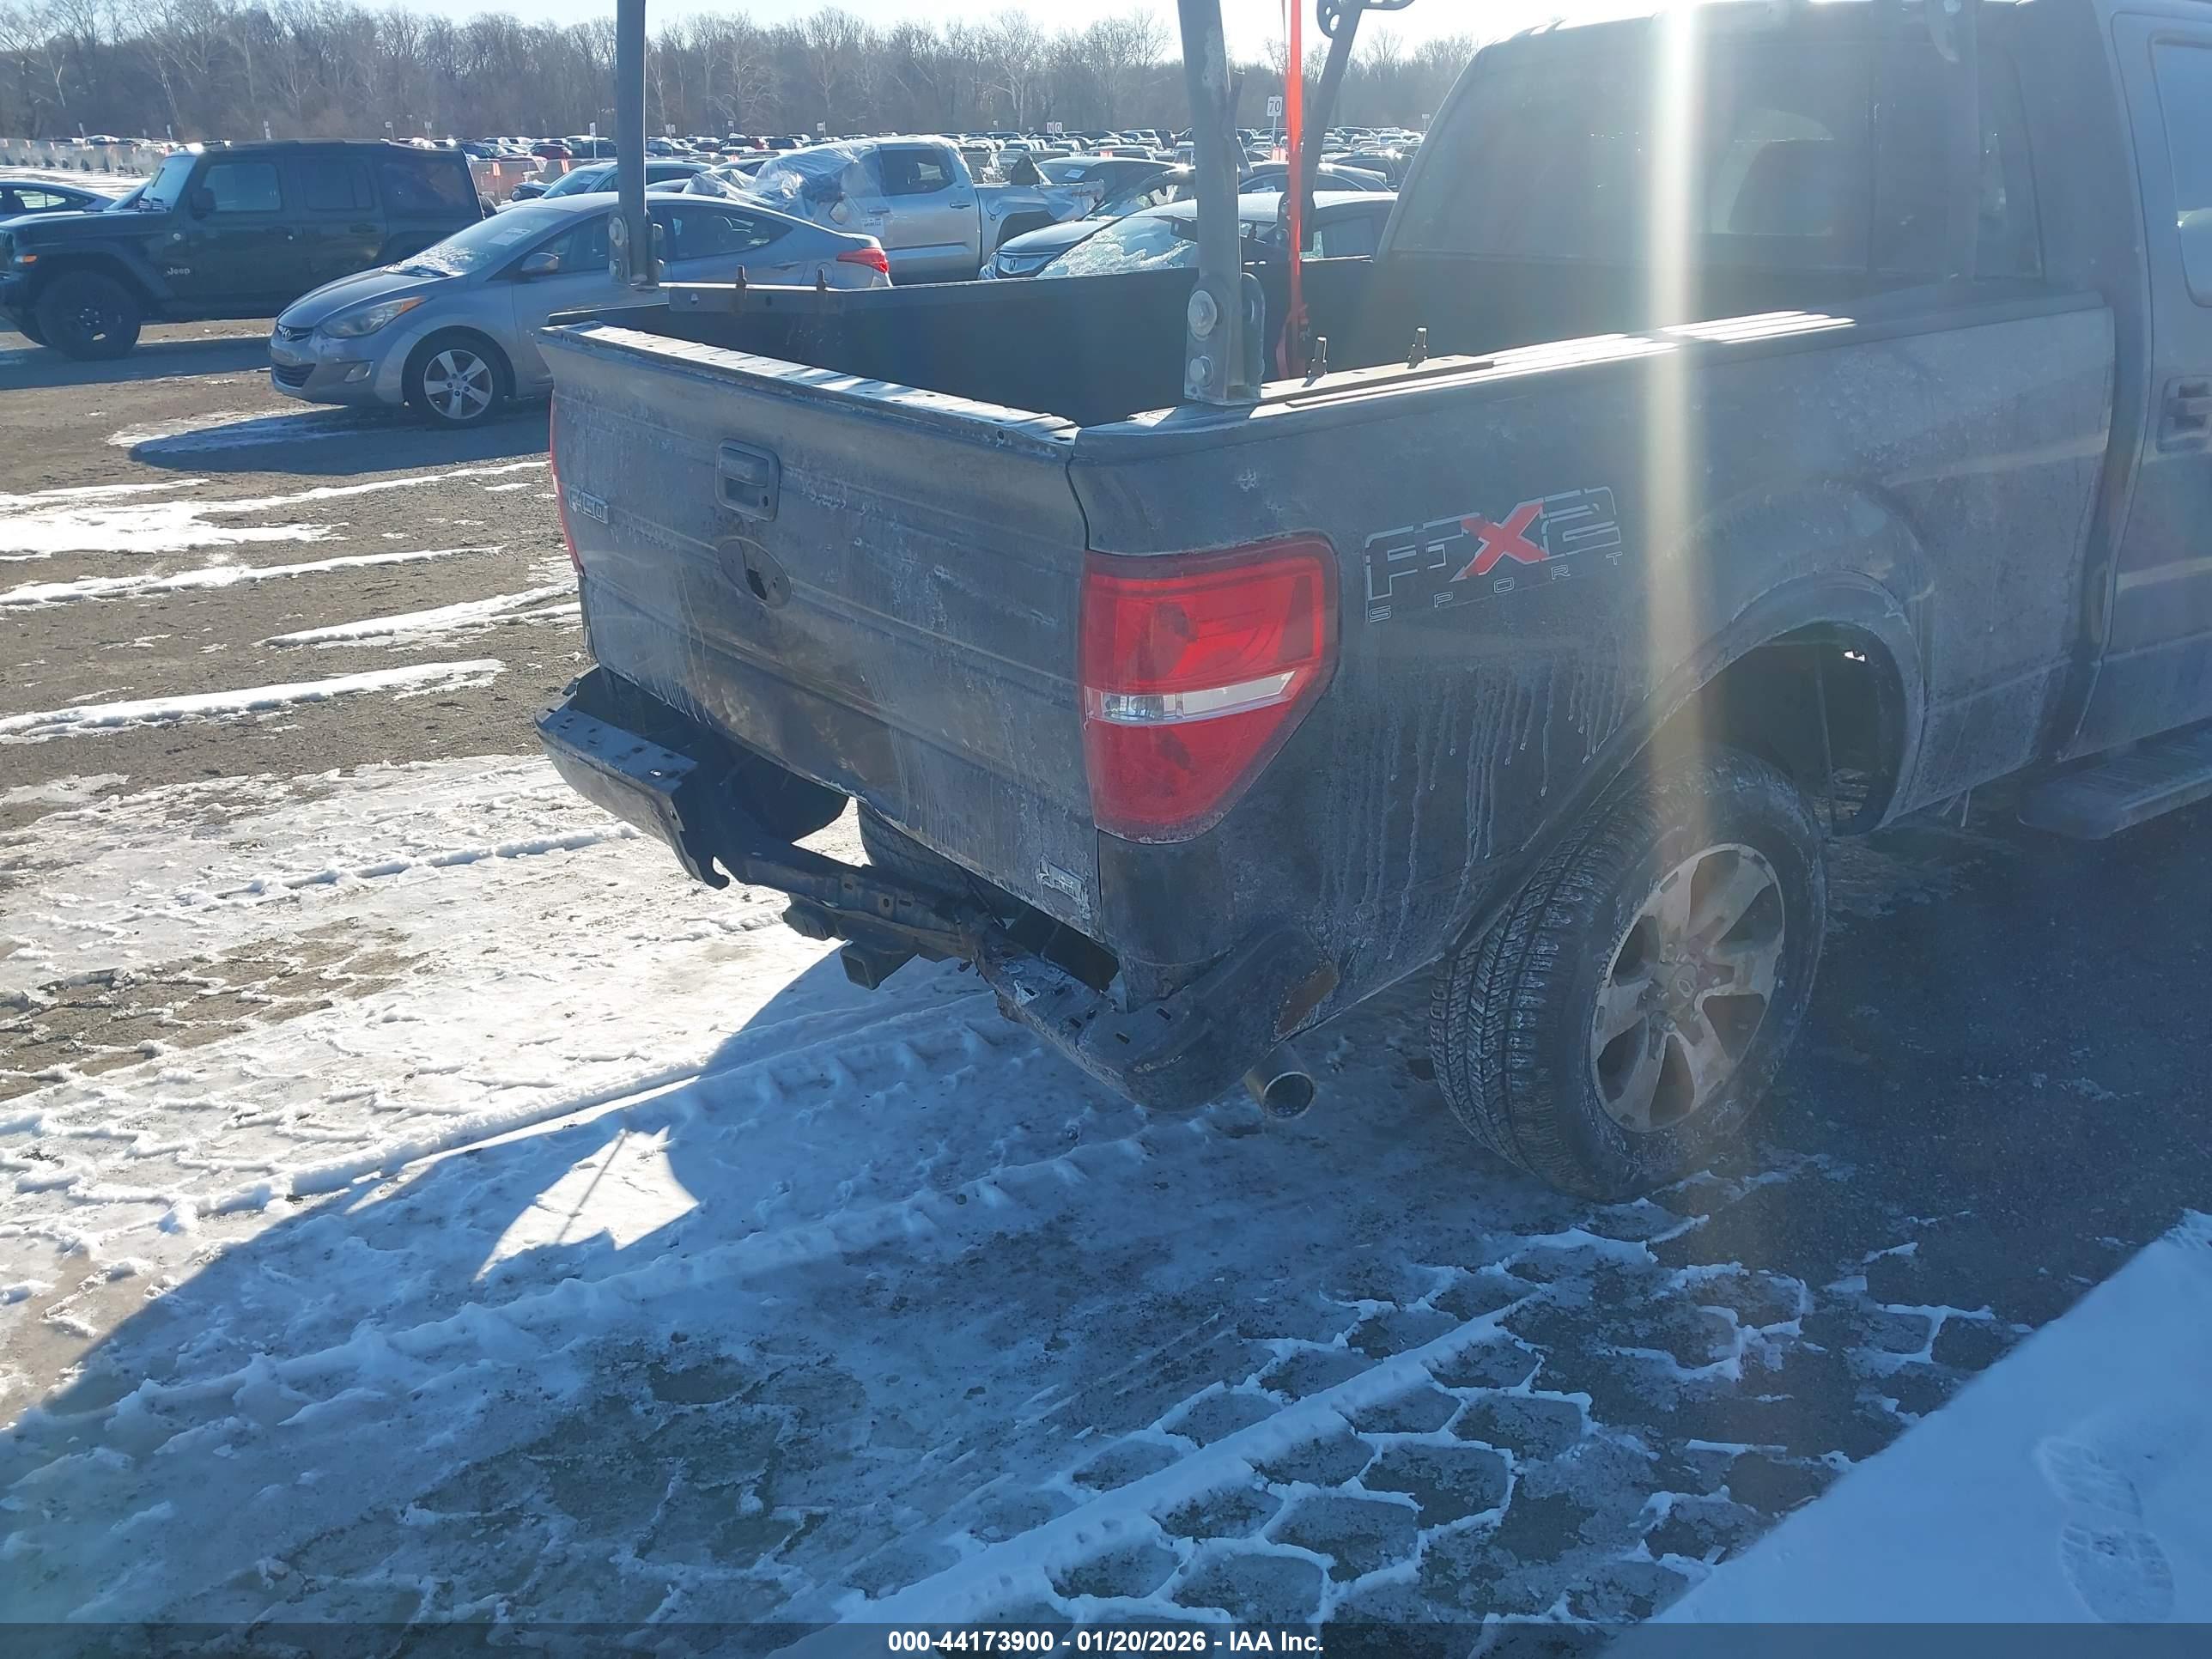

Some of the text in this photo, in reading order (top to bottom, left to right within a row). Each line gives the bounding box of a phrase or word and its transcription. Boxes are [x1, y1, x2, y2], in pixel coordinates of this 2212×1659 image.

[1268, 100, 1281, 112] 70
[167, 267, 191, 276] Jeep
[1364, 485, 1622, 601] FX2
[1368, 550, 1623, 623] SPORT
